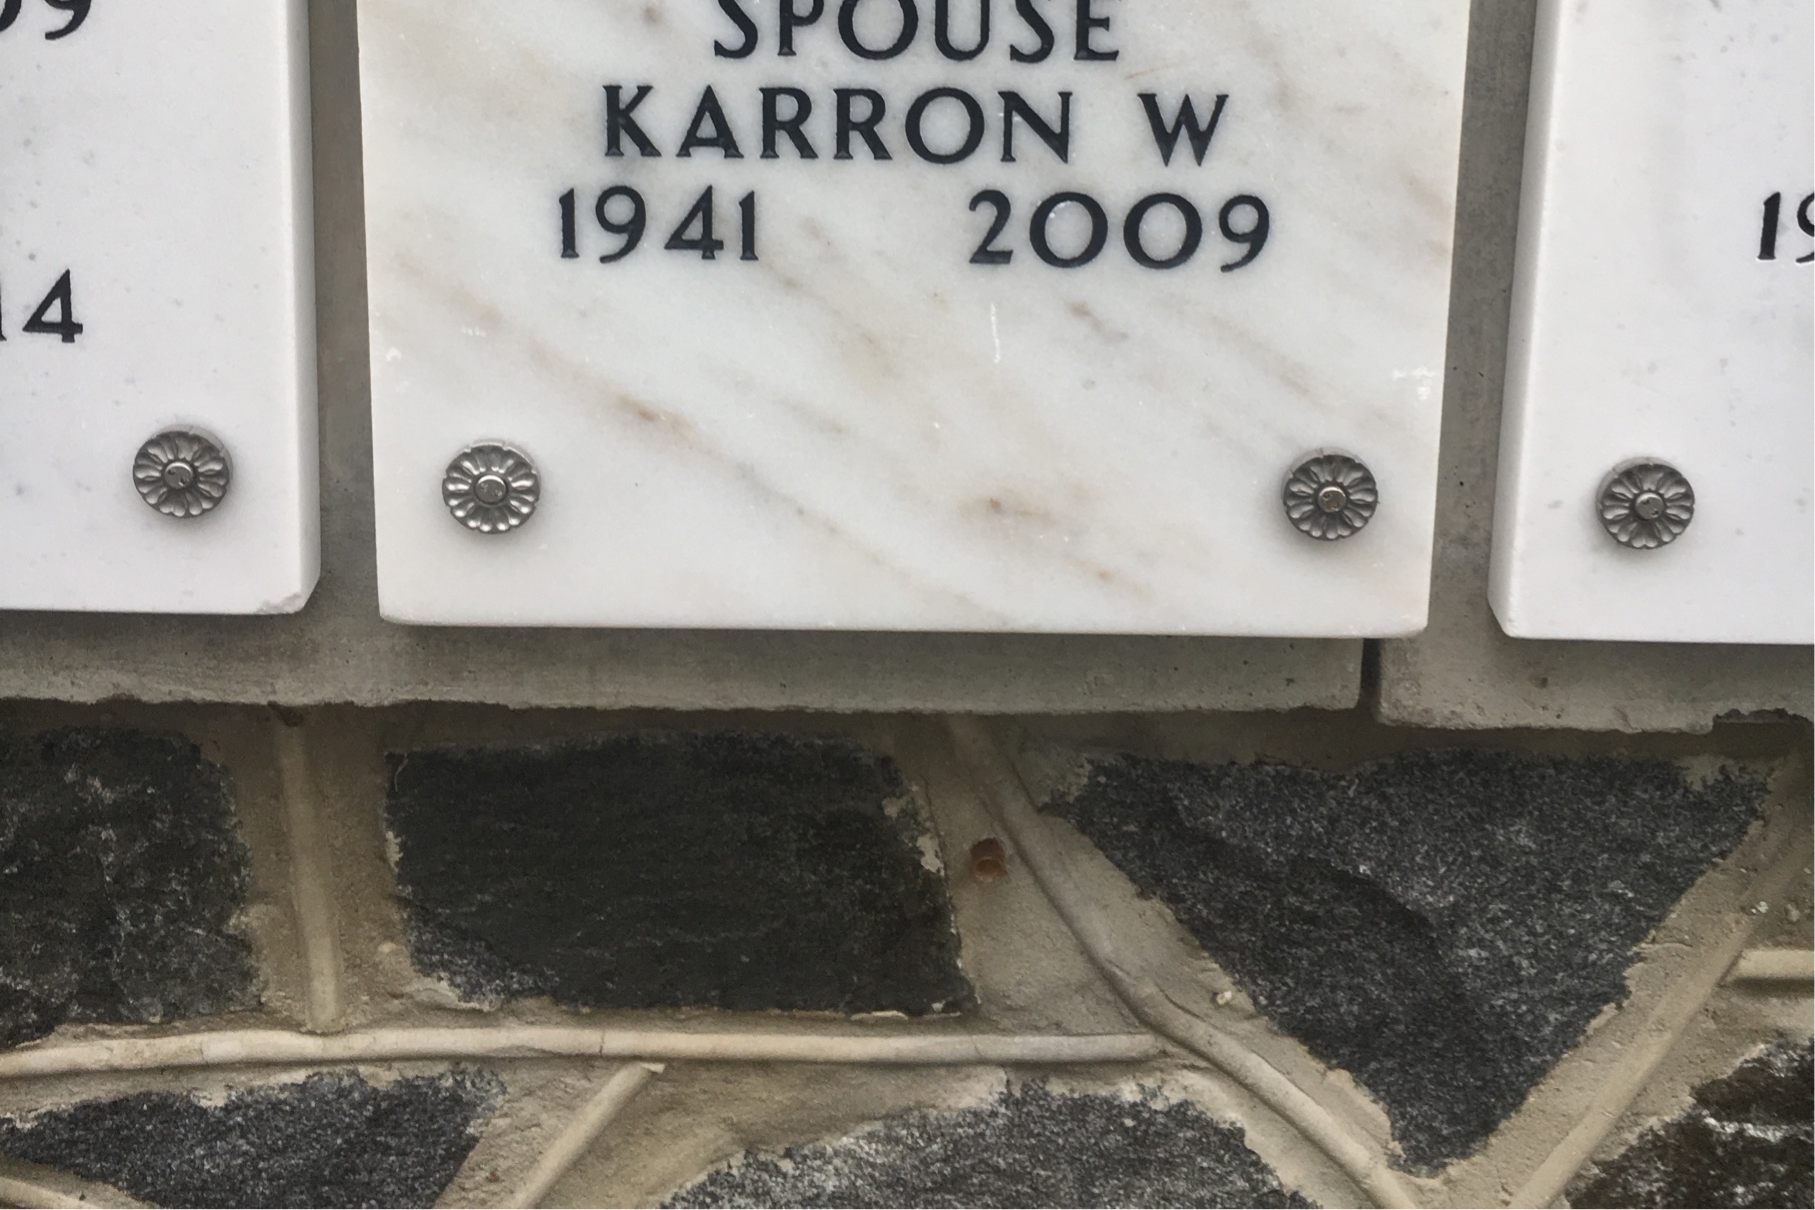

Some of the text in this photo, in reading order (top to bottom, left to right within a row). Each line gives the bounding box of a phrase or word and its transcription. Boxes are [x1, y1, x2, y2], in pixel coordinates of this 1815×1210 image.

[602, 84, 1230, 167] KARRON W
[558, 184, 1270, 273] 1941 2009
[0, 268, 84, 344] 4
